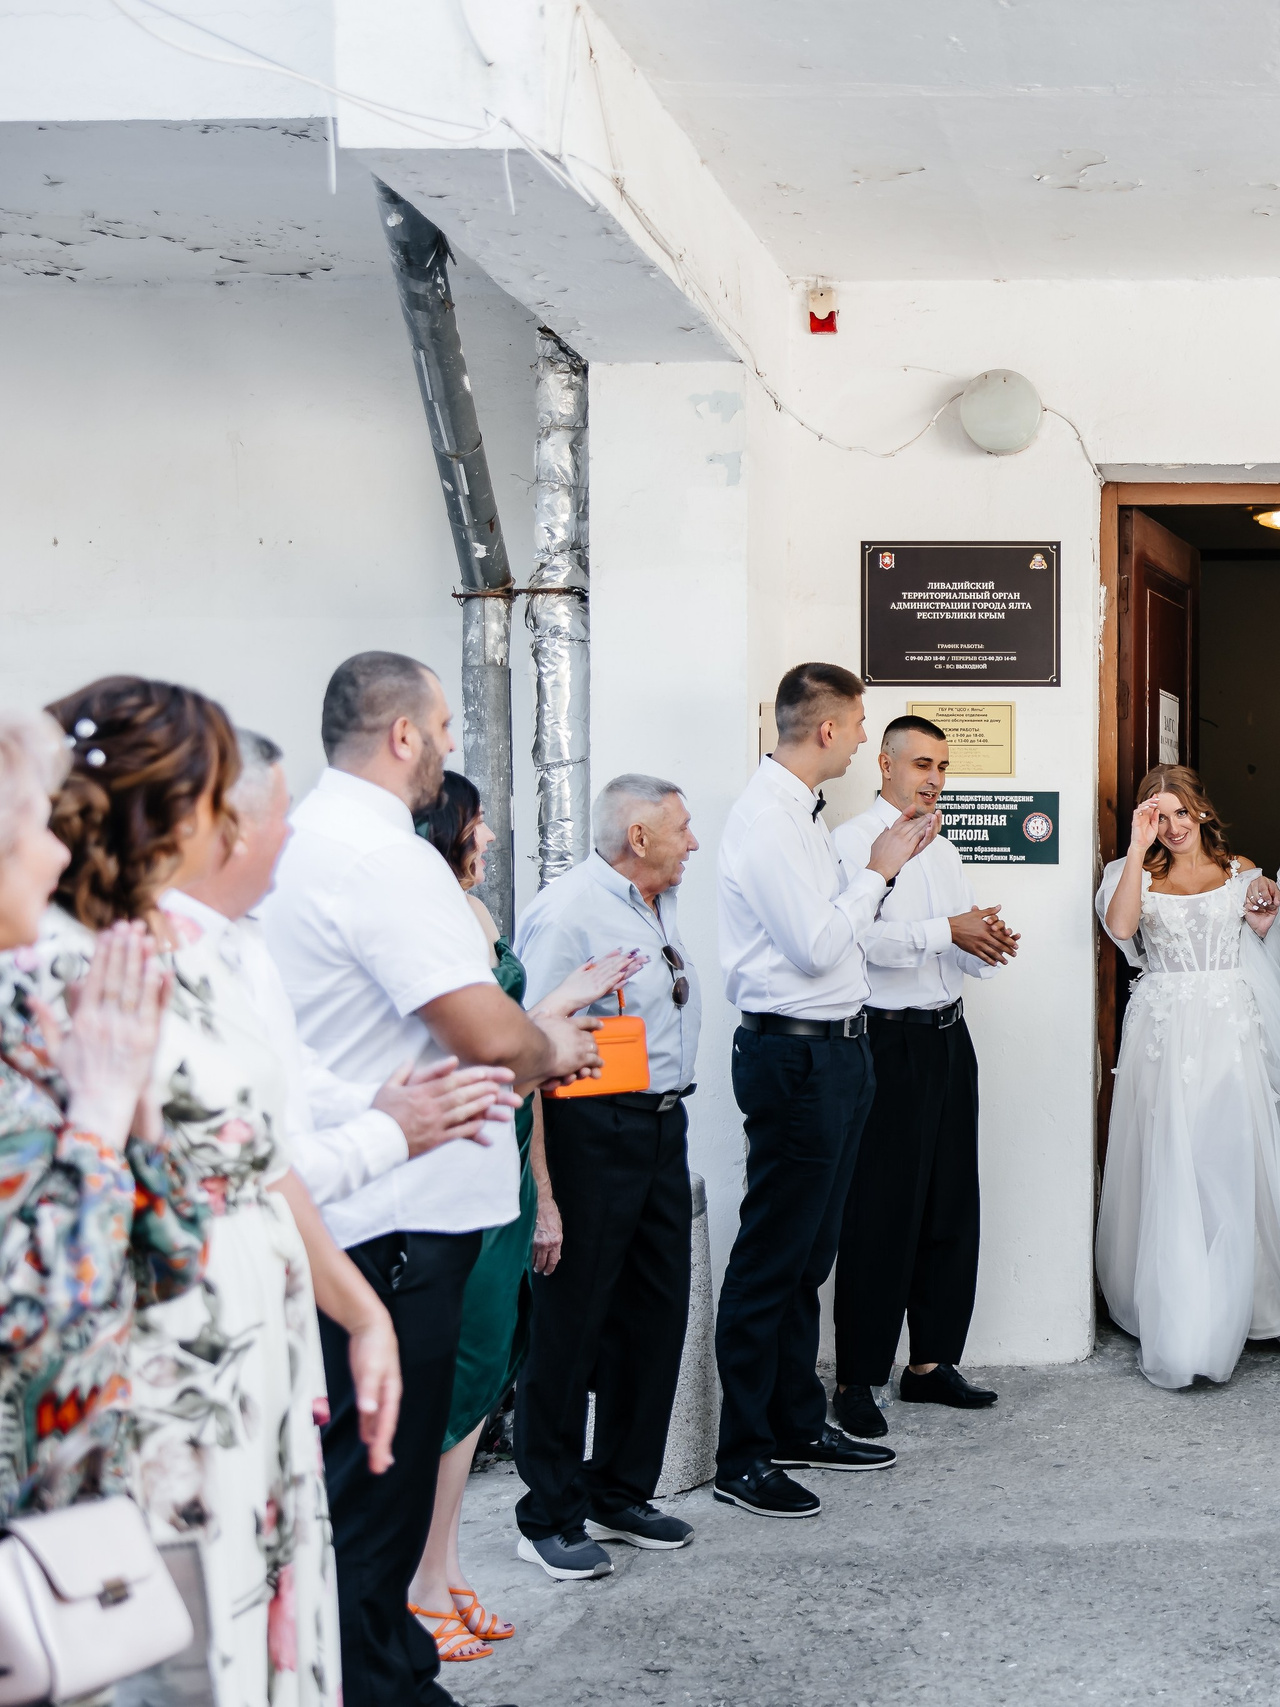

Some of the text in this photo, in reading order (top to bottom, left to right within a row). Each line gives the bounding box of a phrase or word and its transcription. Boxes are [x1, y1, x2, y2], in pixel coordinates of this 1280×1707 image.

[927, 581, 995, 590] ЛИВАДИЙСКИЙ
[902, 591, 1021, 600] ТЕРРИТОРИАЛЬНЫЙ ОРГАН
[890, 602, 1032, 610] АДМИНИСТРАЦИИ ГОРОДА ЯЛТА
[917, 612, 1005, 620] РЕСПУБЛИКИ КРЫМ
[947, 829, 990, 841] ШКОЛА
[974, 854, 1008, 862] Республики
